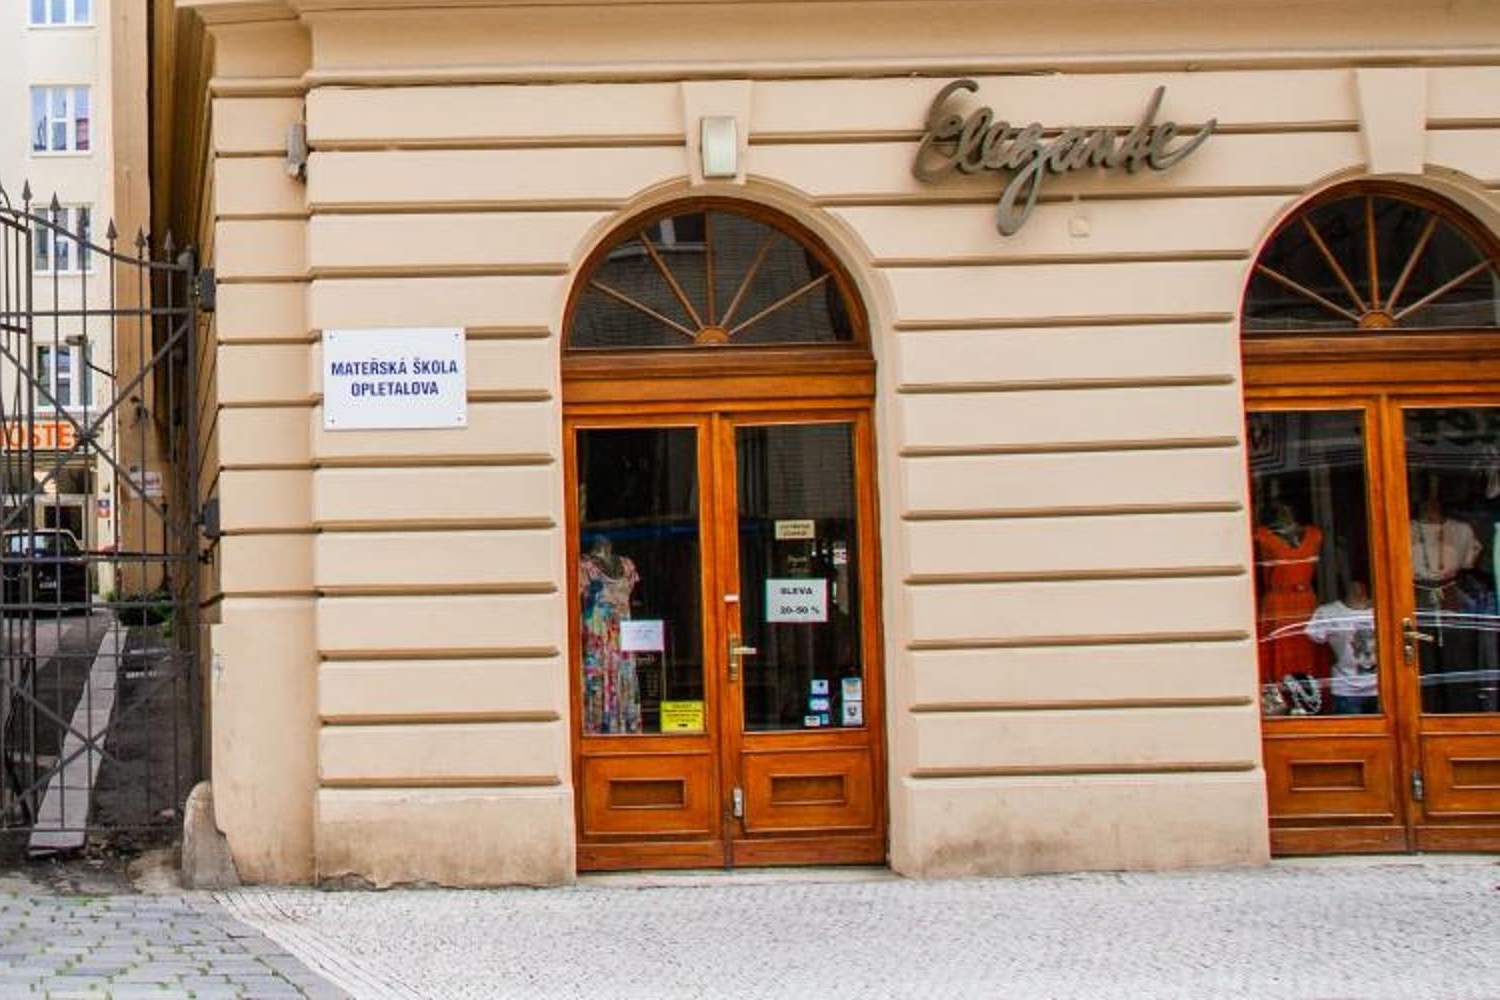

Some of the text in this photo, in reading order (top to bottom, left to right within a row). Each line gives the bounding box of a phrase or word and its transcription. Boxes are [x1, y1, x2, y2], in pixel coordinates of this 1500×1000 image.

[331, 357, 458, 376] MATEŘSKÁ ŠKOLA
[351, 381, 439, 397] OPLETALOVA
